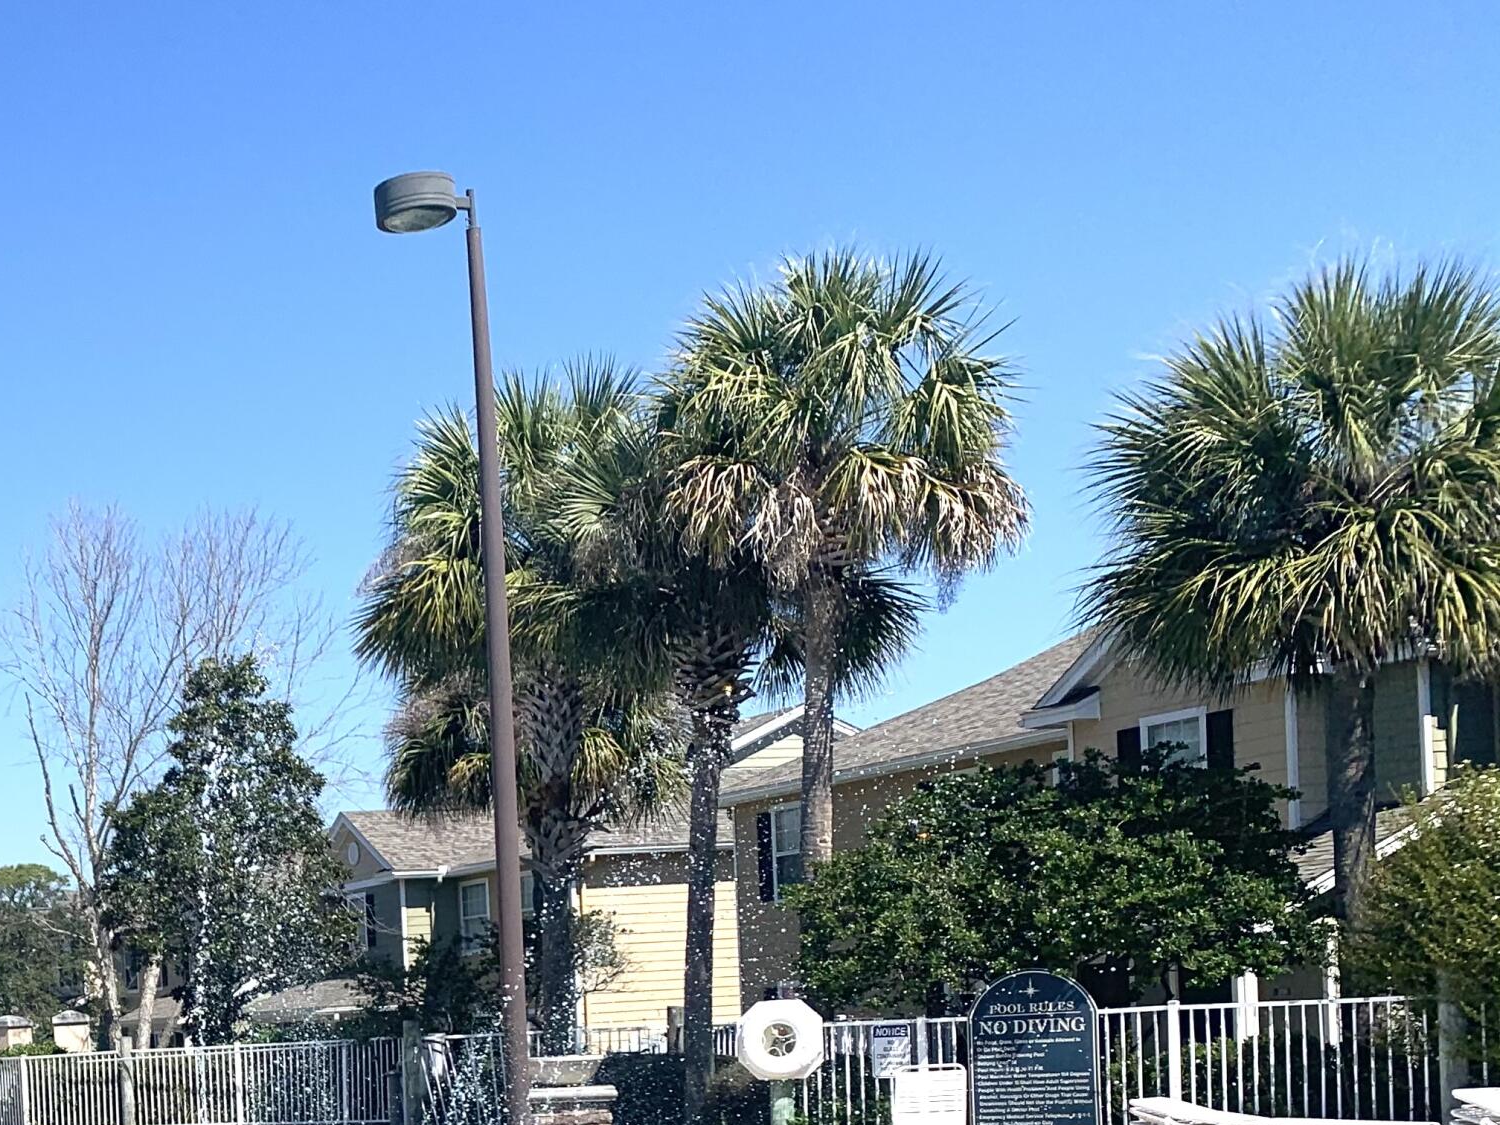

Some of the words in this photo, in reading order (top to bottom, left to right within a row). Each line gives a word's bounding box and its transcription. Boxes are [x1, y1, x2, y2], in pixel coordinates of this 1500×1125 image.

[989, 1003, 1026, 1015] POOL
[1030, 1000, 1075, 1012] RULES
[979, 1020, 1008, 1035] NO
[1013, 1016, 1086, 1034] DIVING
